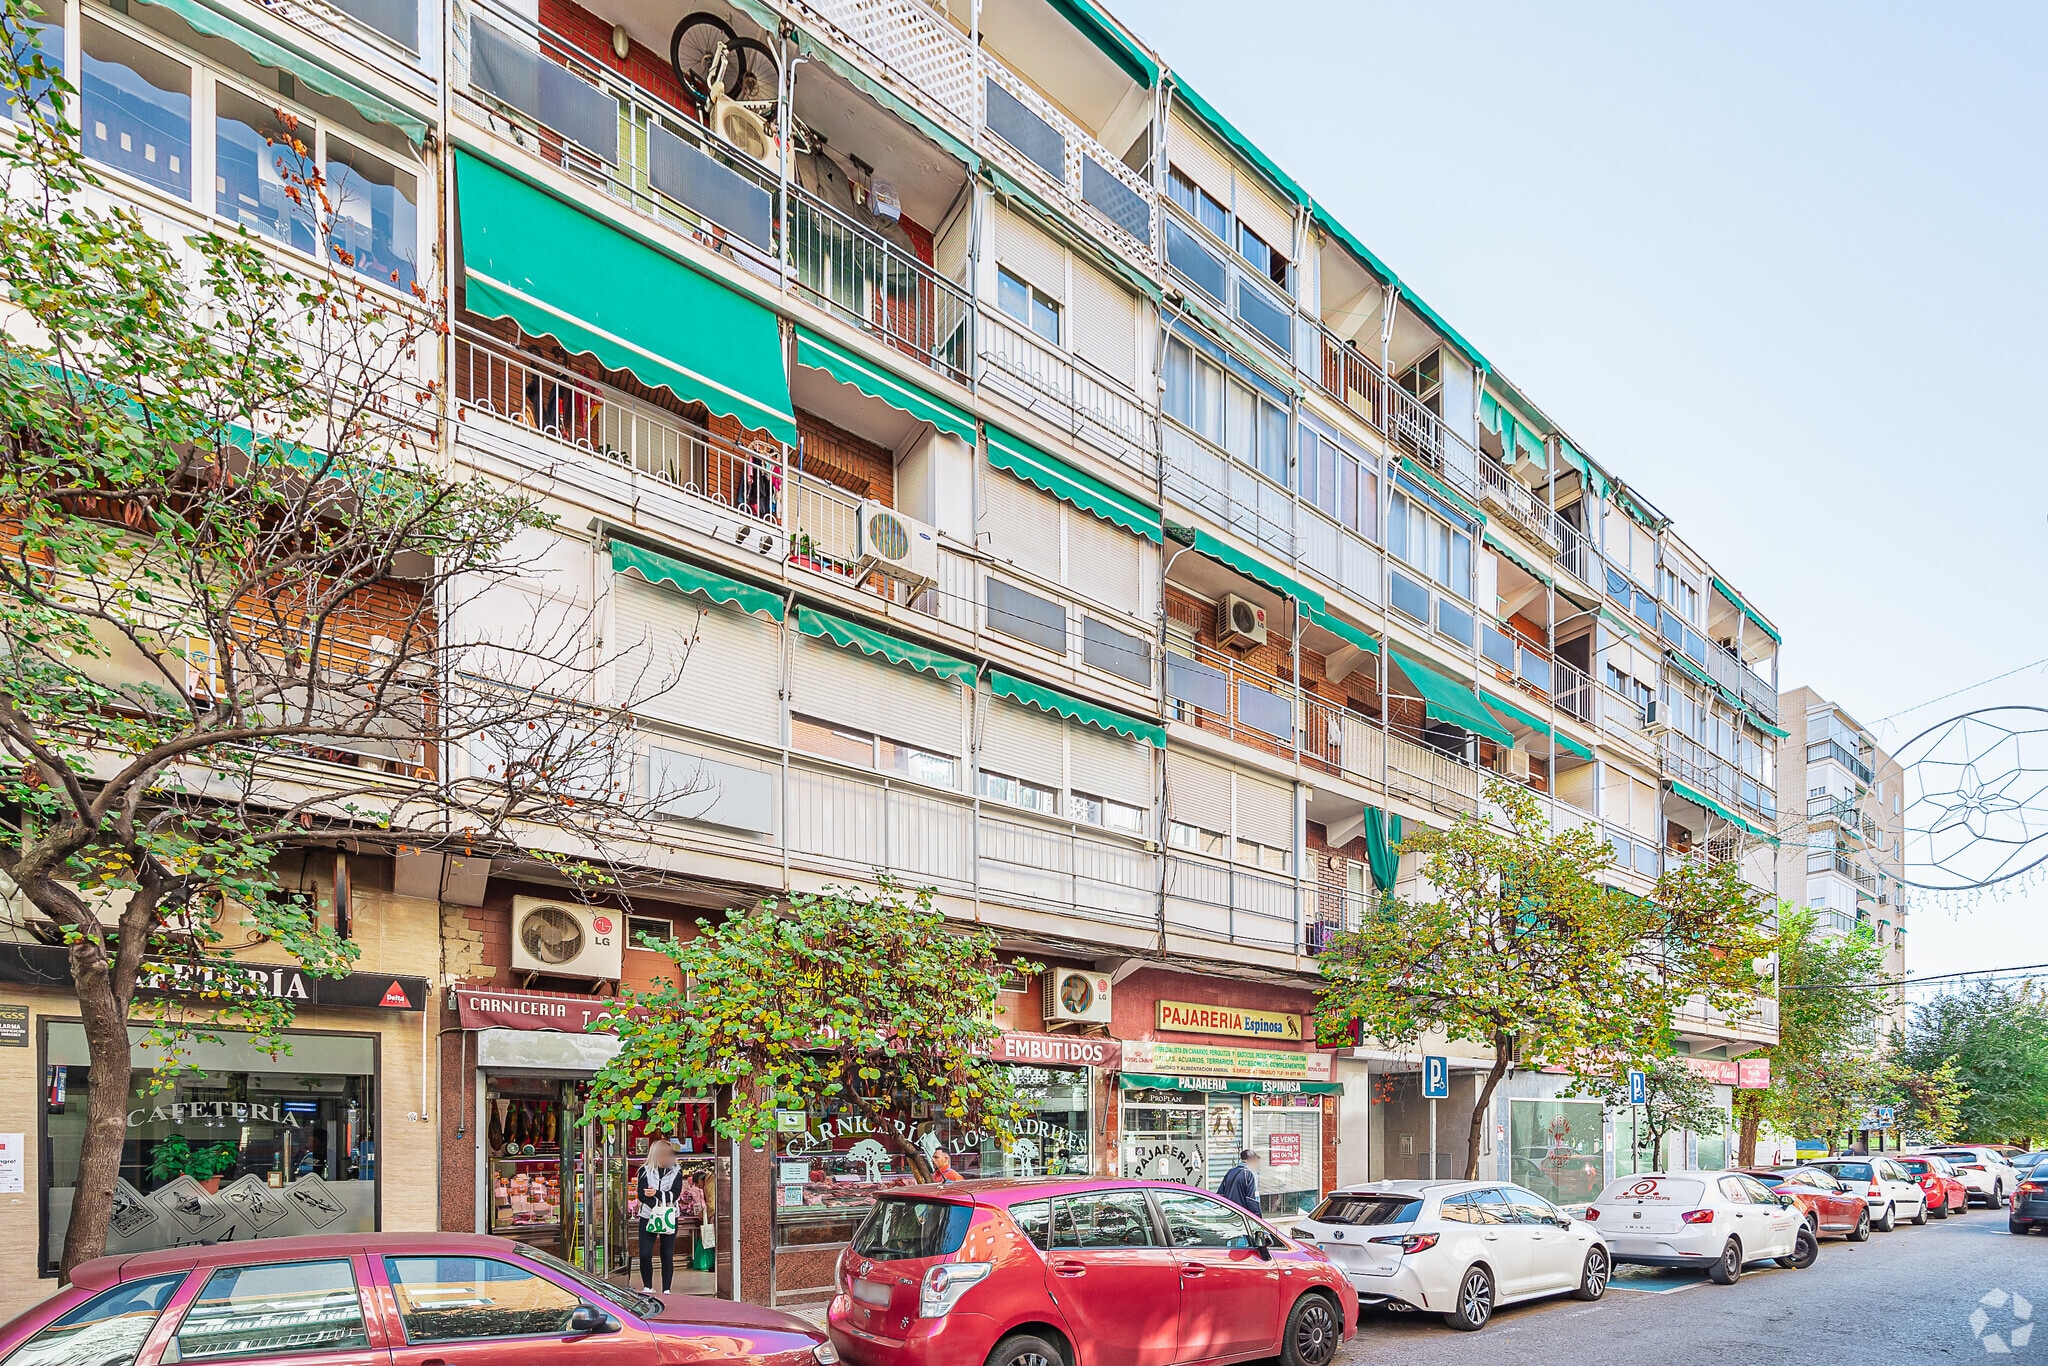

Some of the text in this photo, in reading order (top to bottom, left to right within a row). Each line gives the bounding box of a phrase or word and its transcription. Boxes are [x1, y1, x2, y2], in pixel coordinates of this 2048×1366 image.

[595, 936, 610, 946] LG
[386, 993, 405, 1002] Delta
[469, 996, 566, 1017] CARNICERIA
[1162, 1006, 1283, 1035] PAJARERIA Espinosa
[1005, 1039, 1103, 1061] EMBUTIDOS
[1178, 1077, 1302, 1093] PAJARERIA ESPINOSA
[1430, 1059, 1441, 1093] P
[1633, 1074, 1641, 1101] P
[126, 1101, 301, 1129] CAFETERÍA
[951, 1125, 989, 1155] LOS
[1281, 1136, 1299, 1144] VENDE
[1135, 1144, 1193, 1177] PAJARERIA
[217, 1224, 236, 1242] 4
